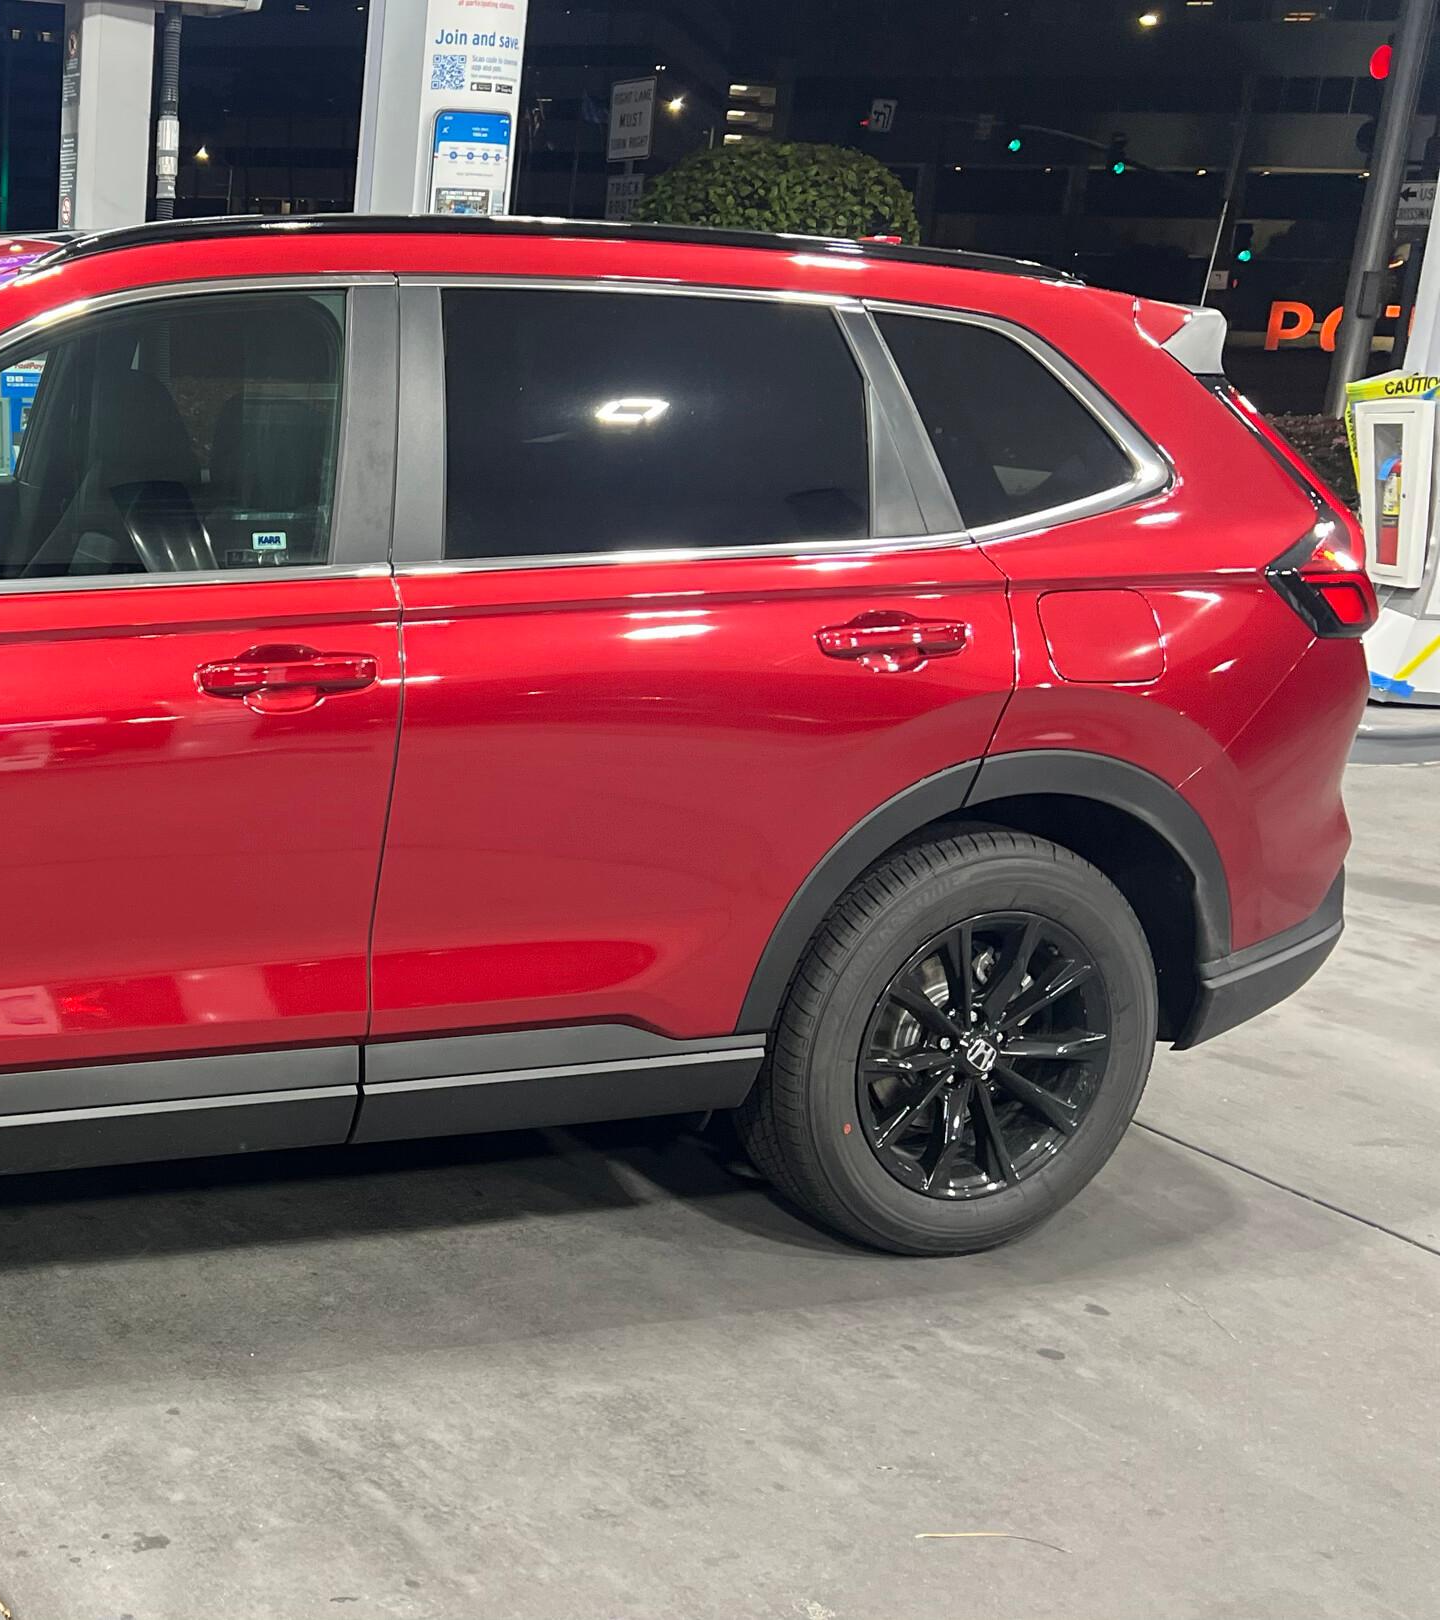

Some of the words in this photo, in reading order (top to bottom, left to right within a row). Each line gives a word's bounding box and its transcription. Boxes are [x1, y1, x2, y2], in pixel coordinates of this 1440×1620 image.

[435, 29, 467, 45] Join
[472, 32, 496, 46] and
[634, 88, 652, 103] LANE
[619, 111, 643, 128] MUST
[1384, 376, 1440, 395] CAUTIO
[257, 535, 281, 545] KARR
